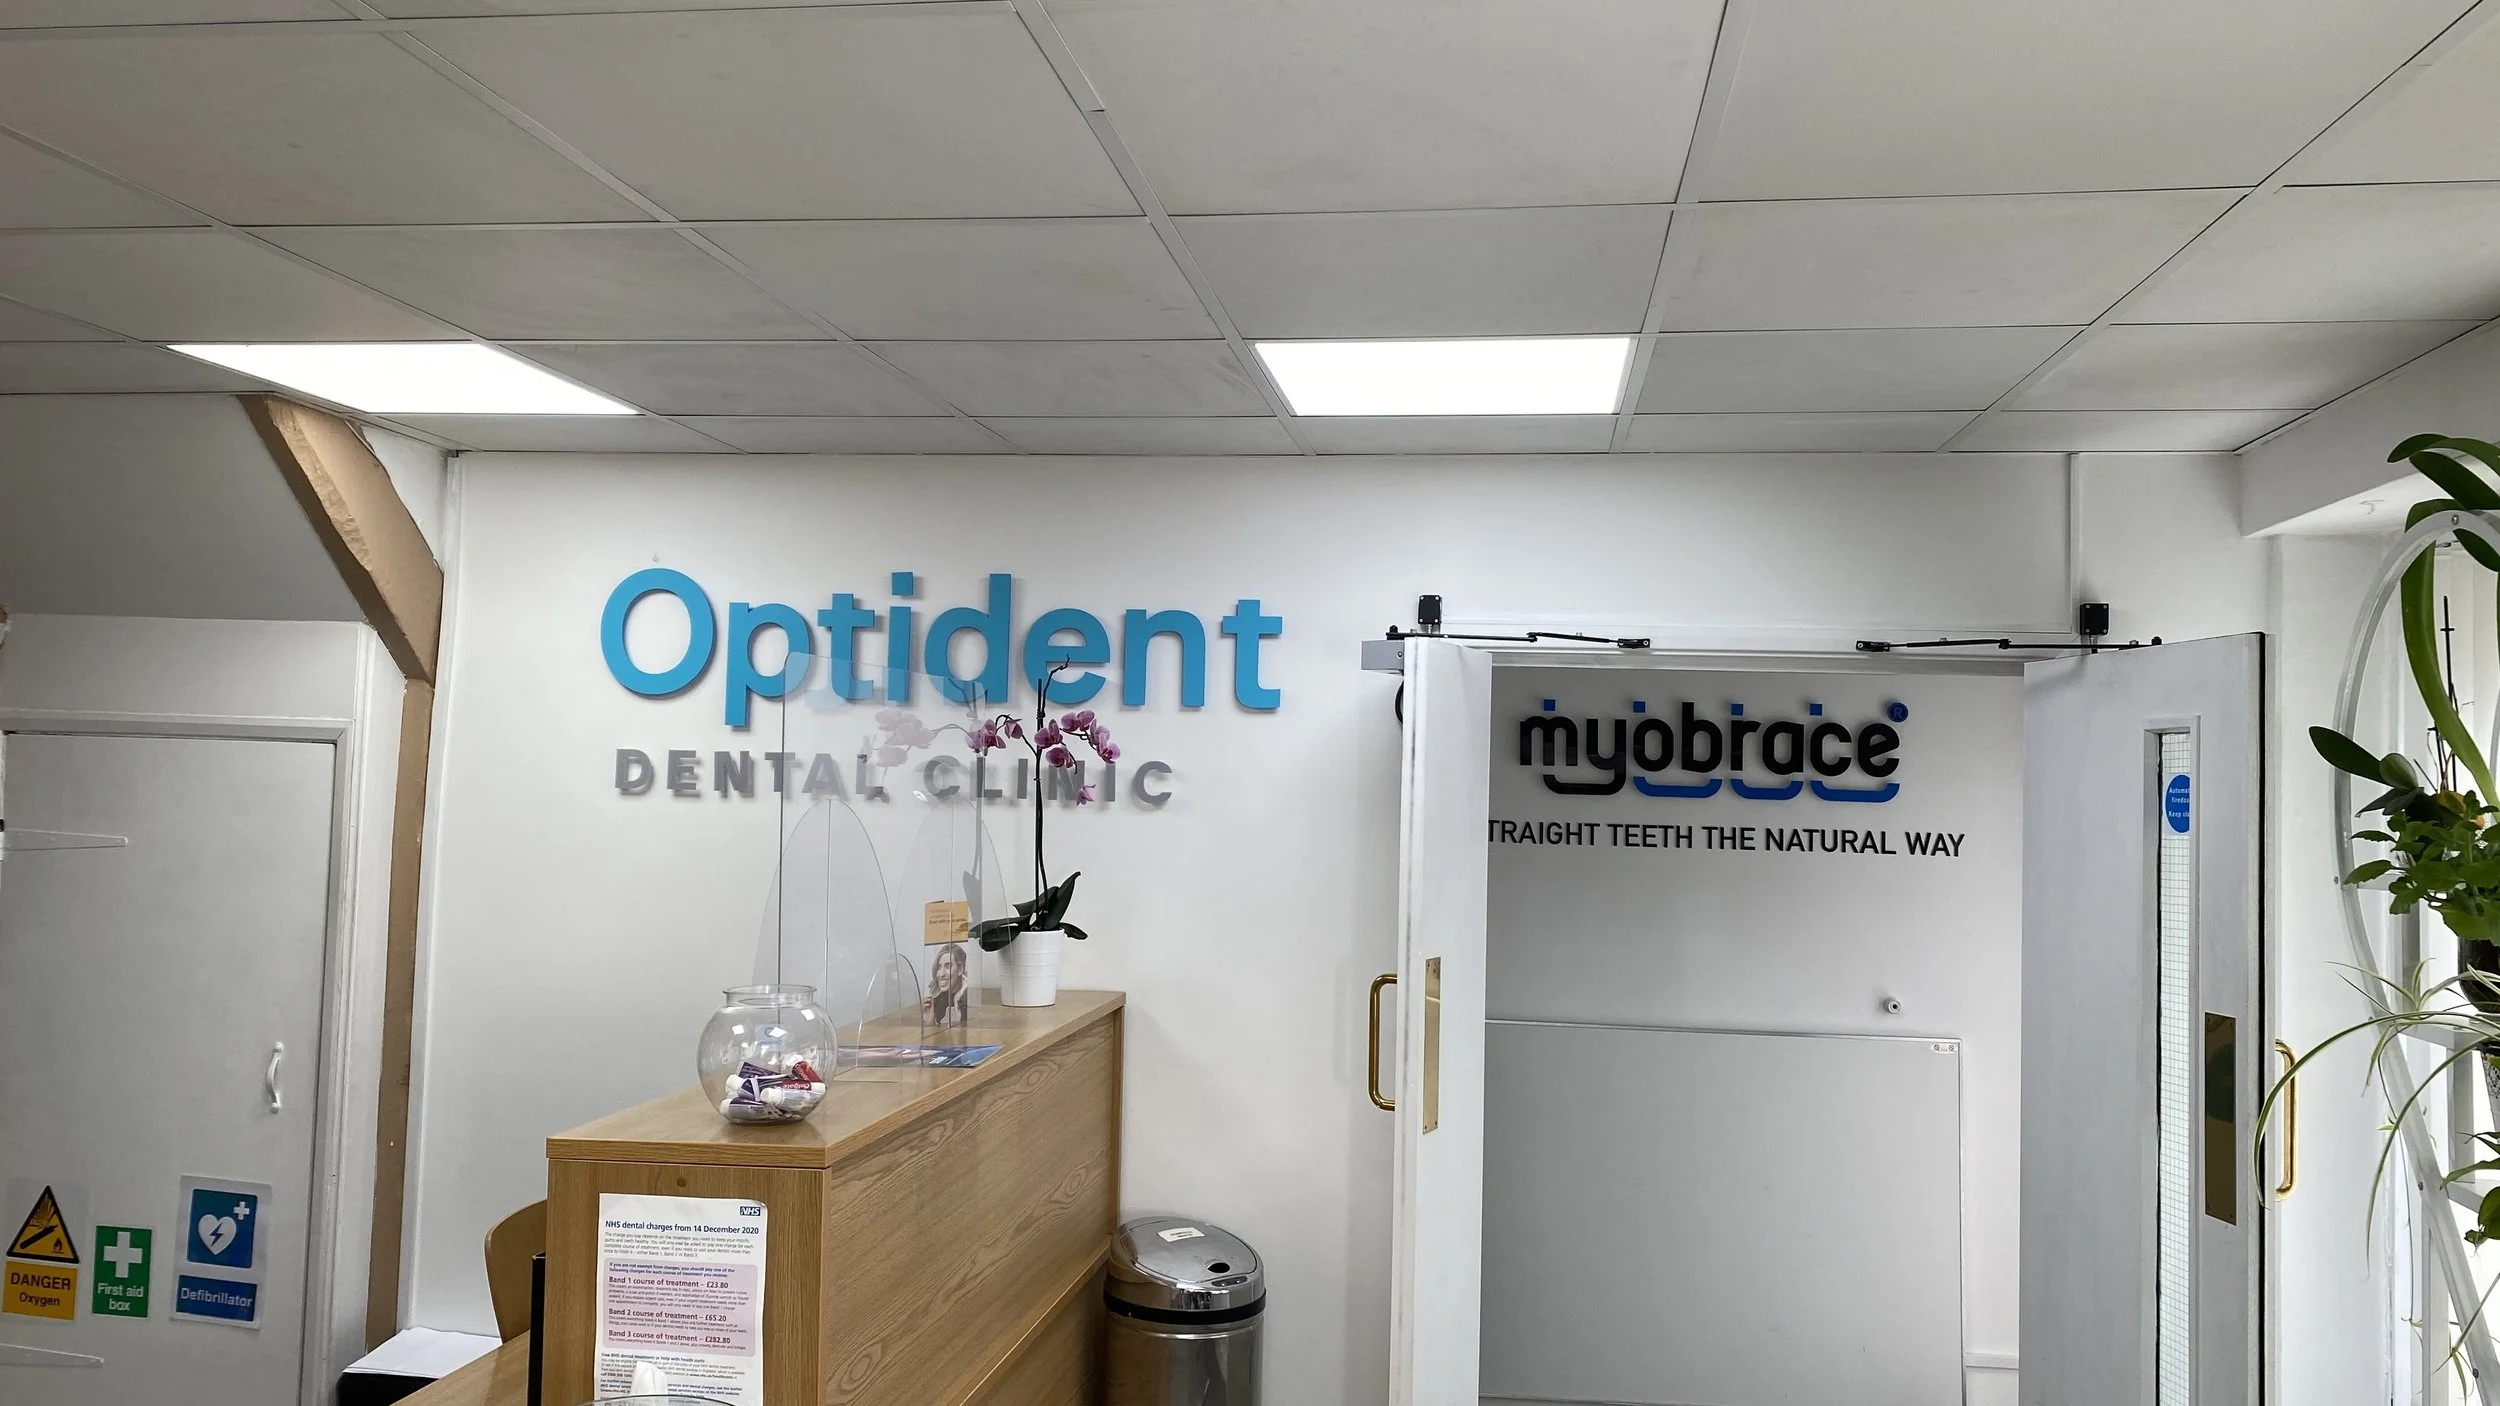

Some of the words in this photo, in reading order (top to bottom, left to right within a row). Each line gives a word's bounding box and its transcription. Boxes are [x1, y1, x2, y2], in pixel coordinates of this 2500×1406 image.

[600, 567, 1283, 727] Optident
[614, 749, 884, 796] DENTAL
[923, 754, 1173, 804] CLINIC
[1488, 819, 1600, 847] TRAIGHT
[1607, 823, 1693, 849] TEETH
[1702, 826, 1756, 851] THE
[1766, 828, 1897, 855] NATURAL
[1905, 832, 1966, 857] WAY
[740, 1207, 760, 1216] NHS
[606, 1220, 620, 1228] NHS
[622, 1221, 644, 1229] dental
[646, 1222, 672, 1232] charges
[704, 1225, 740, 1234] December
[742, 1227, 758, 1235] 2020
[10, 1272, 71, 1291] DANGER
[665, 1279, 699, 1287] treatment
[98, 1283, 124, 1296] First
[126, 1285, 144, 1298] aid
[181, 1287, 253, 1307] Defibrillator
[19, 1292, 60, 1307] Oxygen
[109, 1298, 131, 1311] box
[632, 1310, 654, 1318] course
[664, 1312, 698, 1320] treatment
[705, 1314, 727, 1322] £65.20
[609, 1330, 625, 1338] Band
[665, 1334, 698, 1342] treatment
[705, 1336, 731, 1344] £282.80
